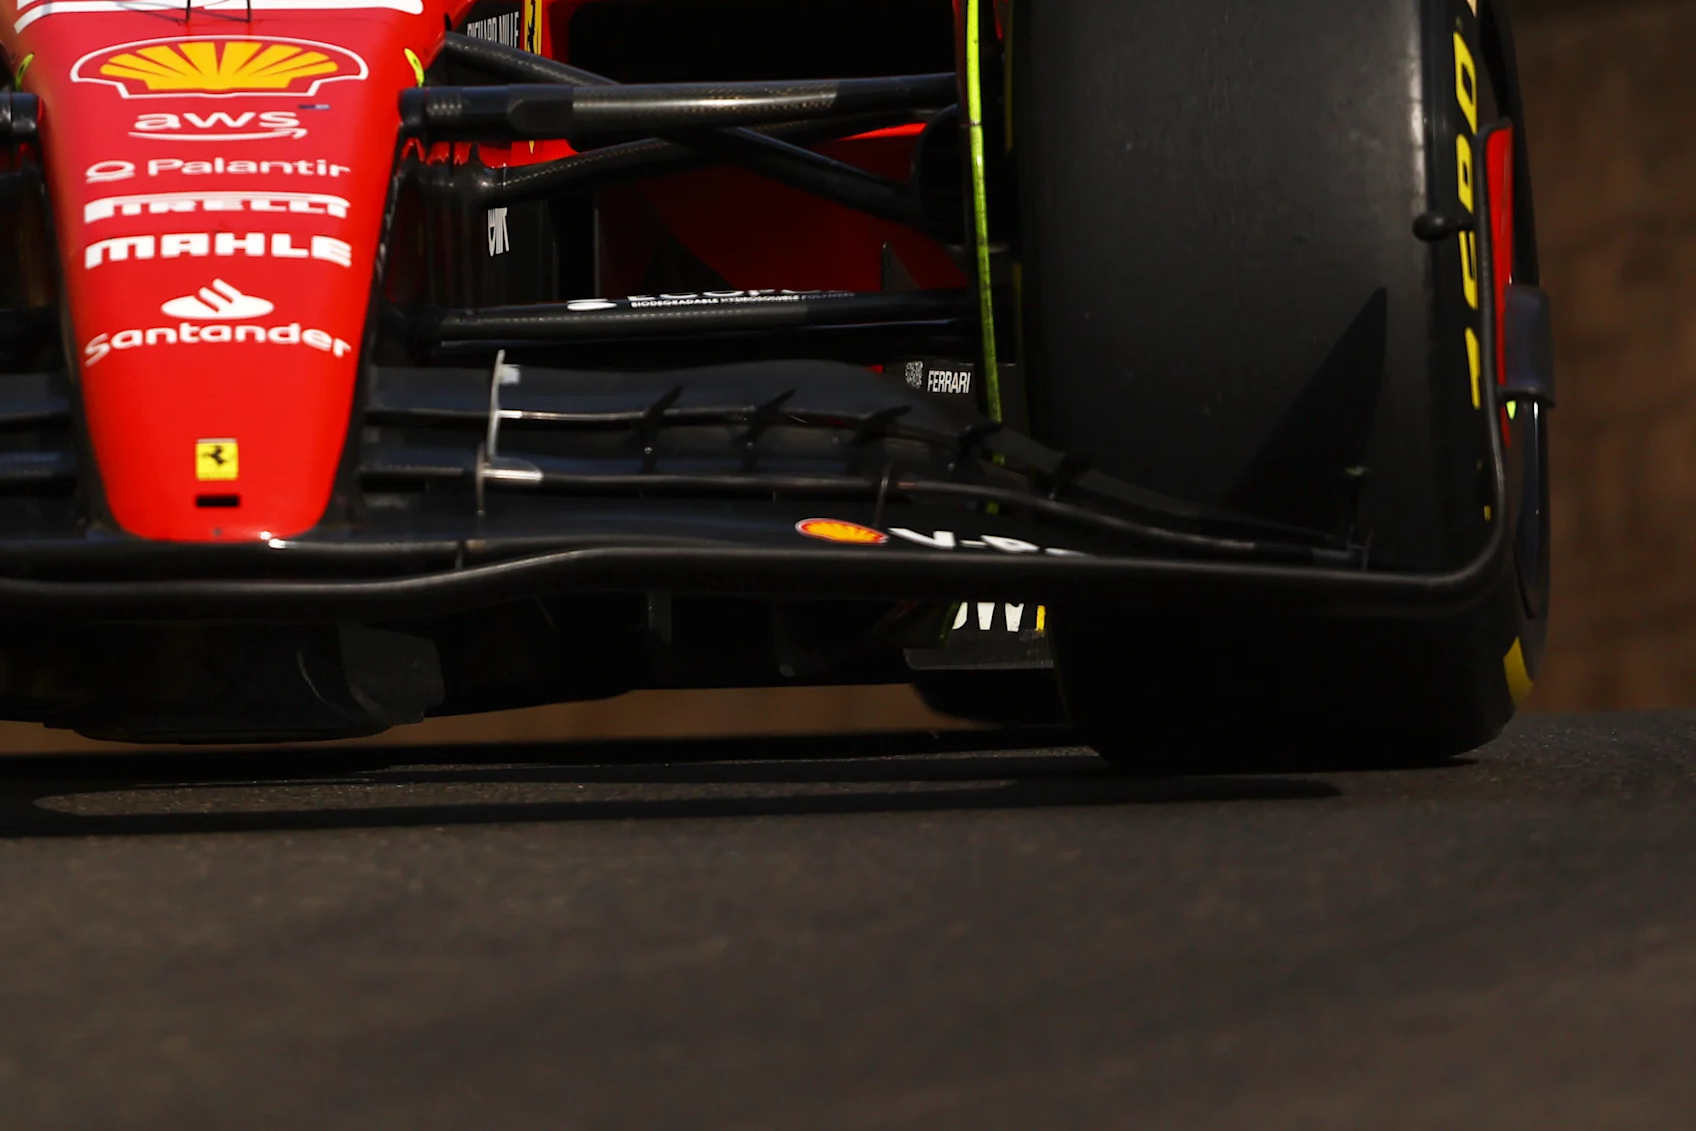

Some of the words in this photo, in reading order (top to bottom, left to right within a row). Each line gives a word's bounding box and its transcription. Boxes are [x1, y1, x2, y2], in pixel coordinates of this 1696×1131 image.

[134, 112, 300, 131] aws
[147, 158, 350, 178] Palantir
[84, 191, 351, 224] PIRELLI
[84, 232, 352, 270] MAHLE
[630, 298, 719, 308] BIODEGRADABLE
[84, 322, 352, 367] Santander
[927, 370, 972, 393] FERRARI
